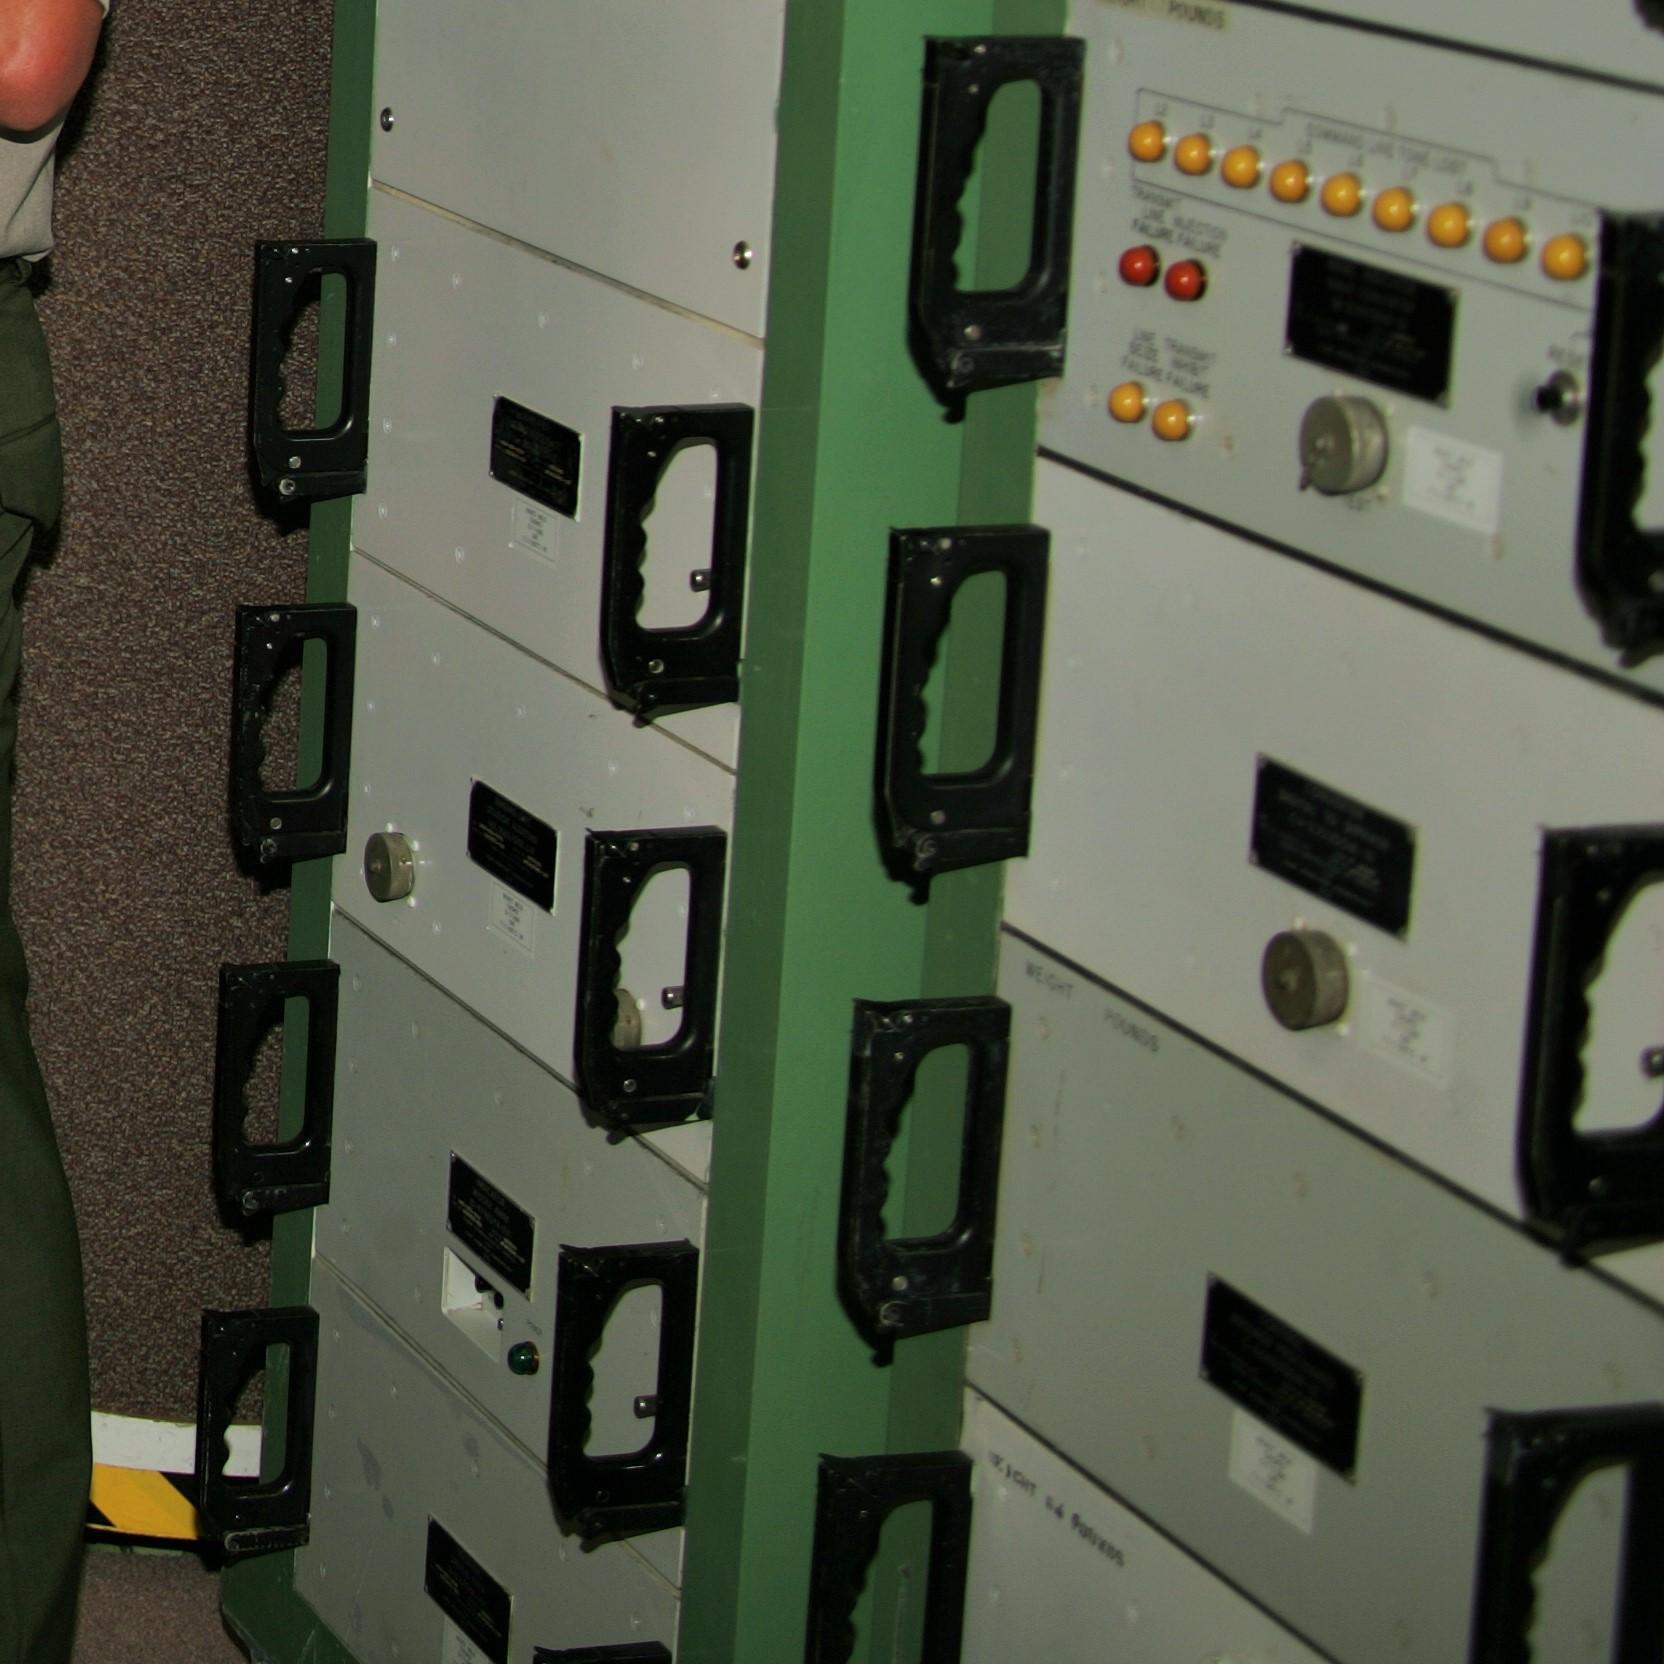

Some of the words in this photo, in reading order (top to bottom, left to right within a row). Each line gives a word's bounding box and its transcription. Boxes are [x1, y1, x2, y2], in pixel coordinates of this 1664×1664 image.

[1168, 0, 1226, 30] POUNDS
[1024, 960, 1074, 1000] WEIGHT
[1104, 1006, 1160, 1053] POUNDS
